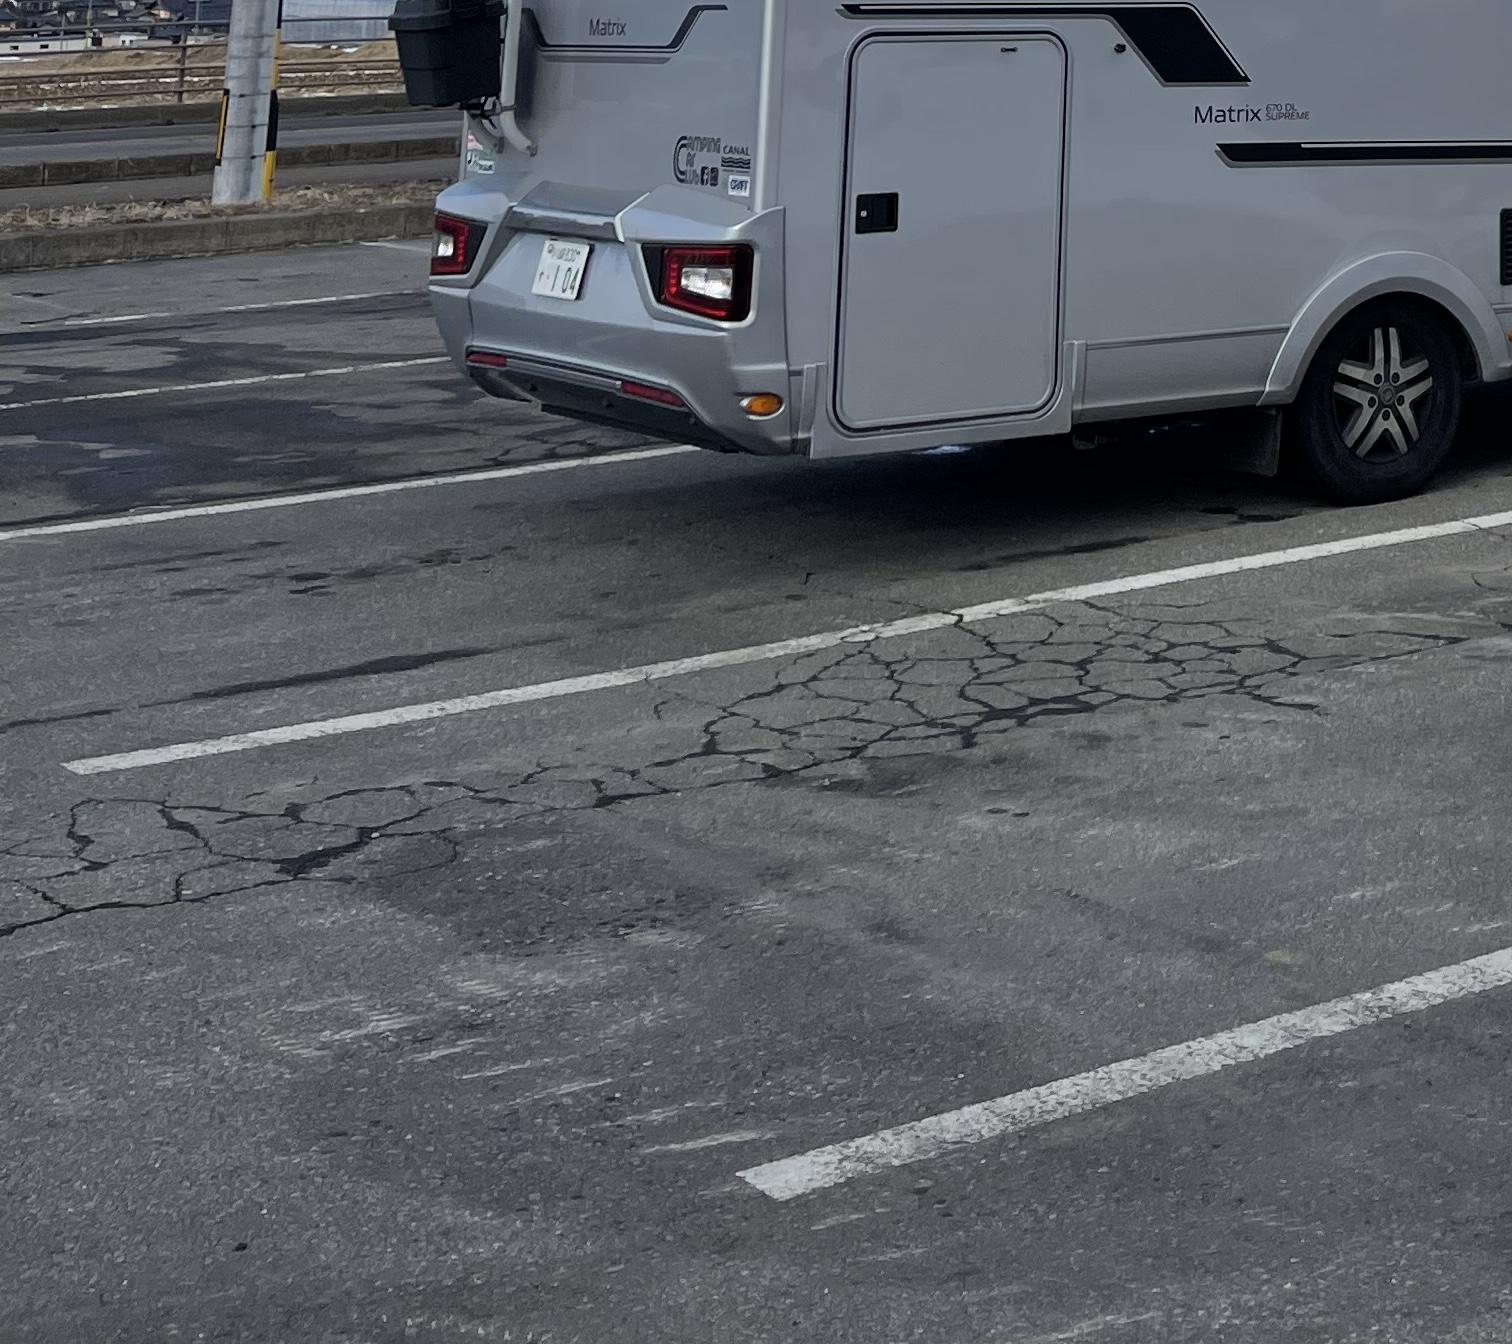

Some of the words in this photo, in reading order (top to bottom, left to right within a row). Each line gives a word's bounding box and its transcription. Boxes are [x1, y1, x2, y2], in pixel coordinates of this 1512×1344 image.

[589, 18, 628, 36] Matrix
[1194, 104, 1262, 124] Matrix
[1265, 111, 1311, 121] SUPREME
[722, 145, 750, 156] CANAL
